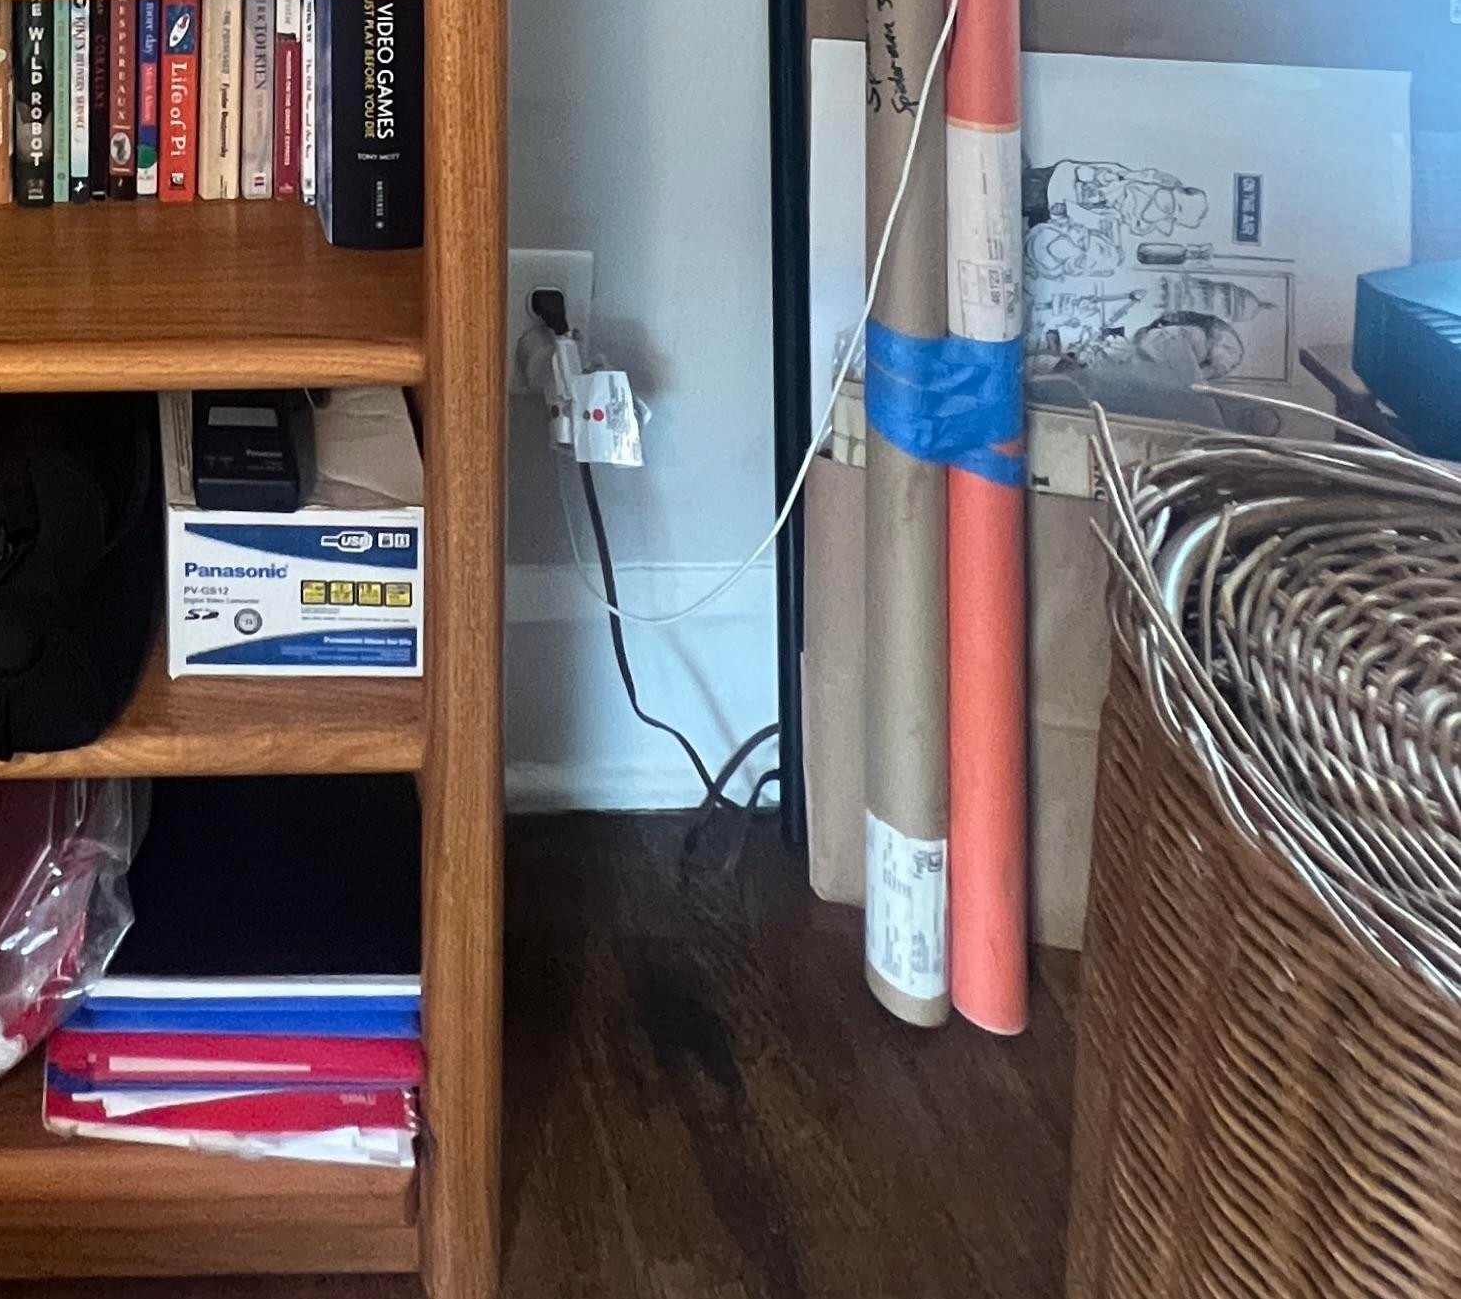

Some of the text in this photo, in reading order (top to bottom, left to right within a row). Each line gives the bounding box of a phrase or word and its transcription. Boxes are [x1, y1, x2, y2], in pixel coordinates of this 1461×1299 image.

[364, 19, 375, 46] PLAY
[364, 48, 375, 86] BEFORE
[376, 2, 394, 140] VIDEO GAMES
[27, 26, 45, 166] WILD ROBOT
[364, 88, 375, 113] YOU
[170, 61, 188, 157] Life of Pi
[364, 115, 375, 134] DIE
[1239, 214, 1254, 236] AIR
[341, 534, 370, 547] USB
[184, 562, 288, 579] Panasonic
[184, 585, 229, 595] PV-GS12
